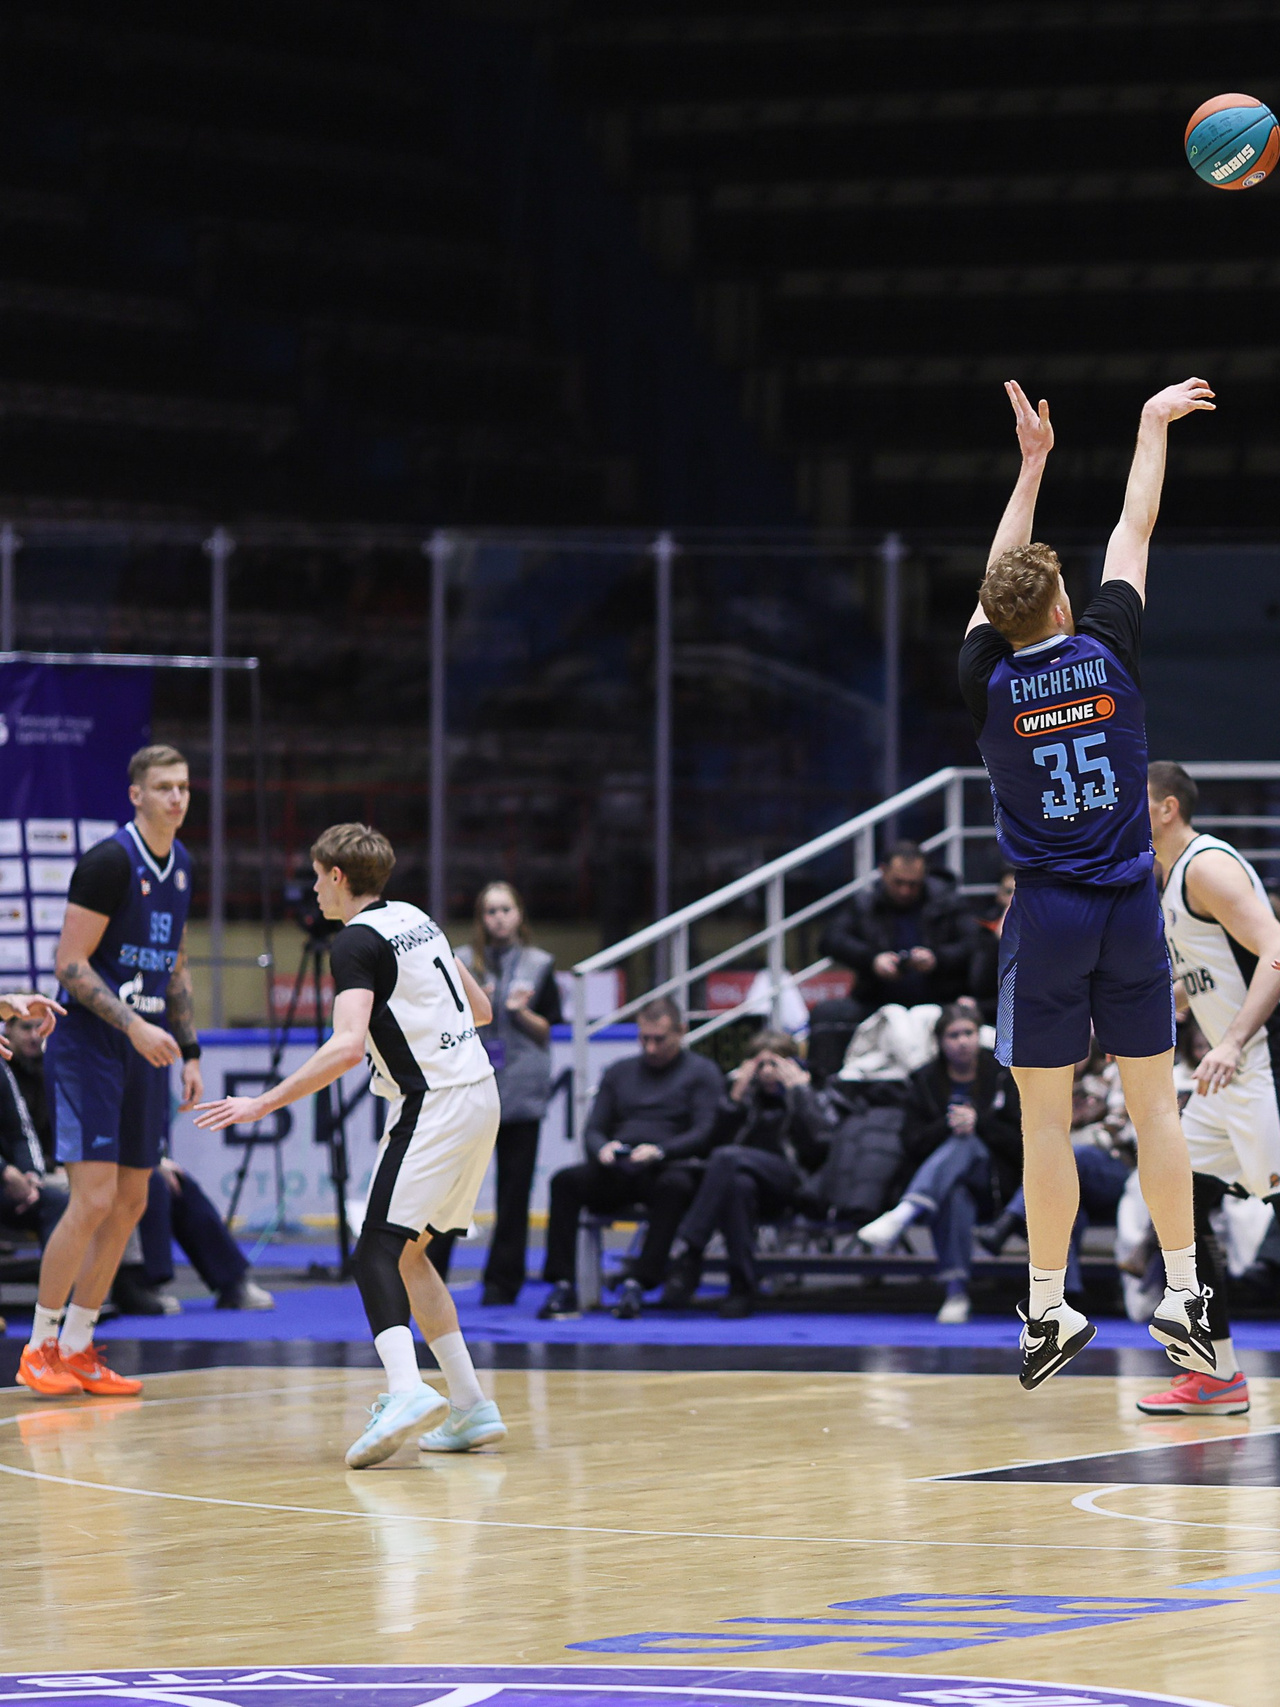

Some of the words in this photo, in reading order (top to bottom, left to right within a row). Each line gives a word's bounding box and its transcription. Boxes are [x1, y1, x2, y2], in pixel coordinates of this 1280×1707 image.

[1211, 144, 1255, 181] SIBUR
[1010, 658, 1108, 704] EMCHENKO
[1022, 703, 1094, 733] WINLINE
[1032, 731, 1119, 822] 35
[432, 955, 465, 1013] 1
[16, 1670, 337, 1687] VTB
